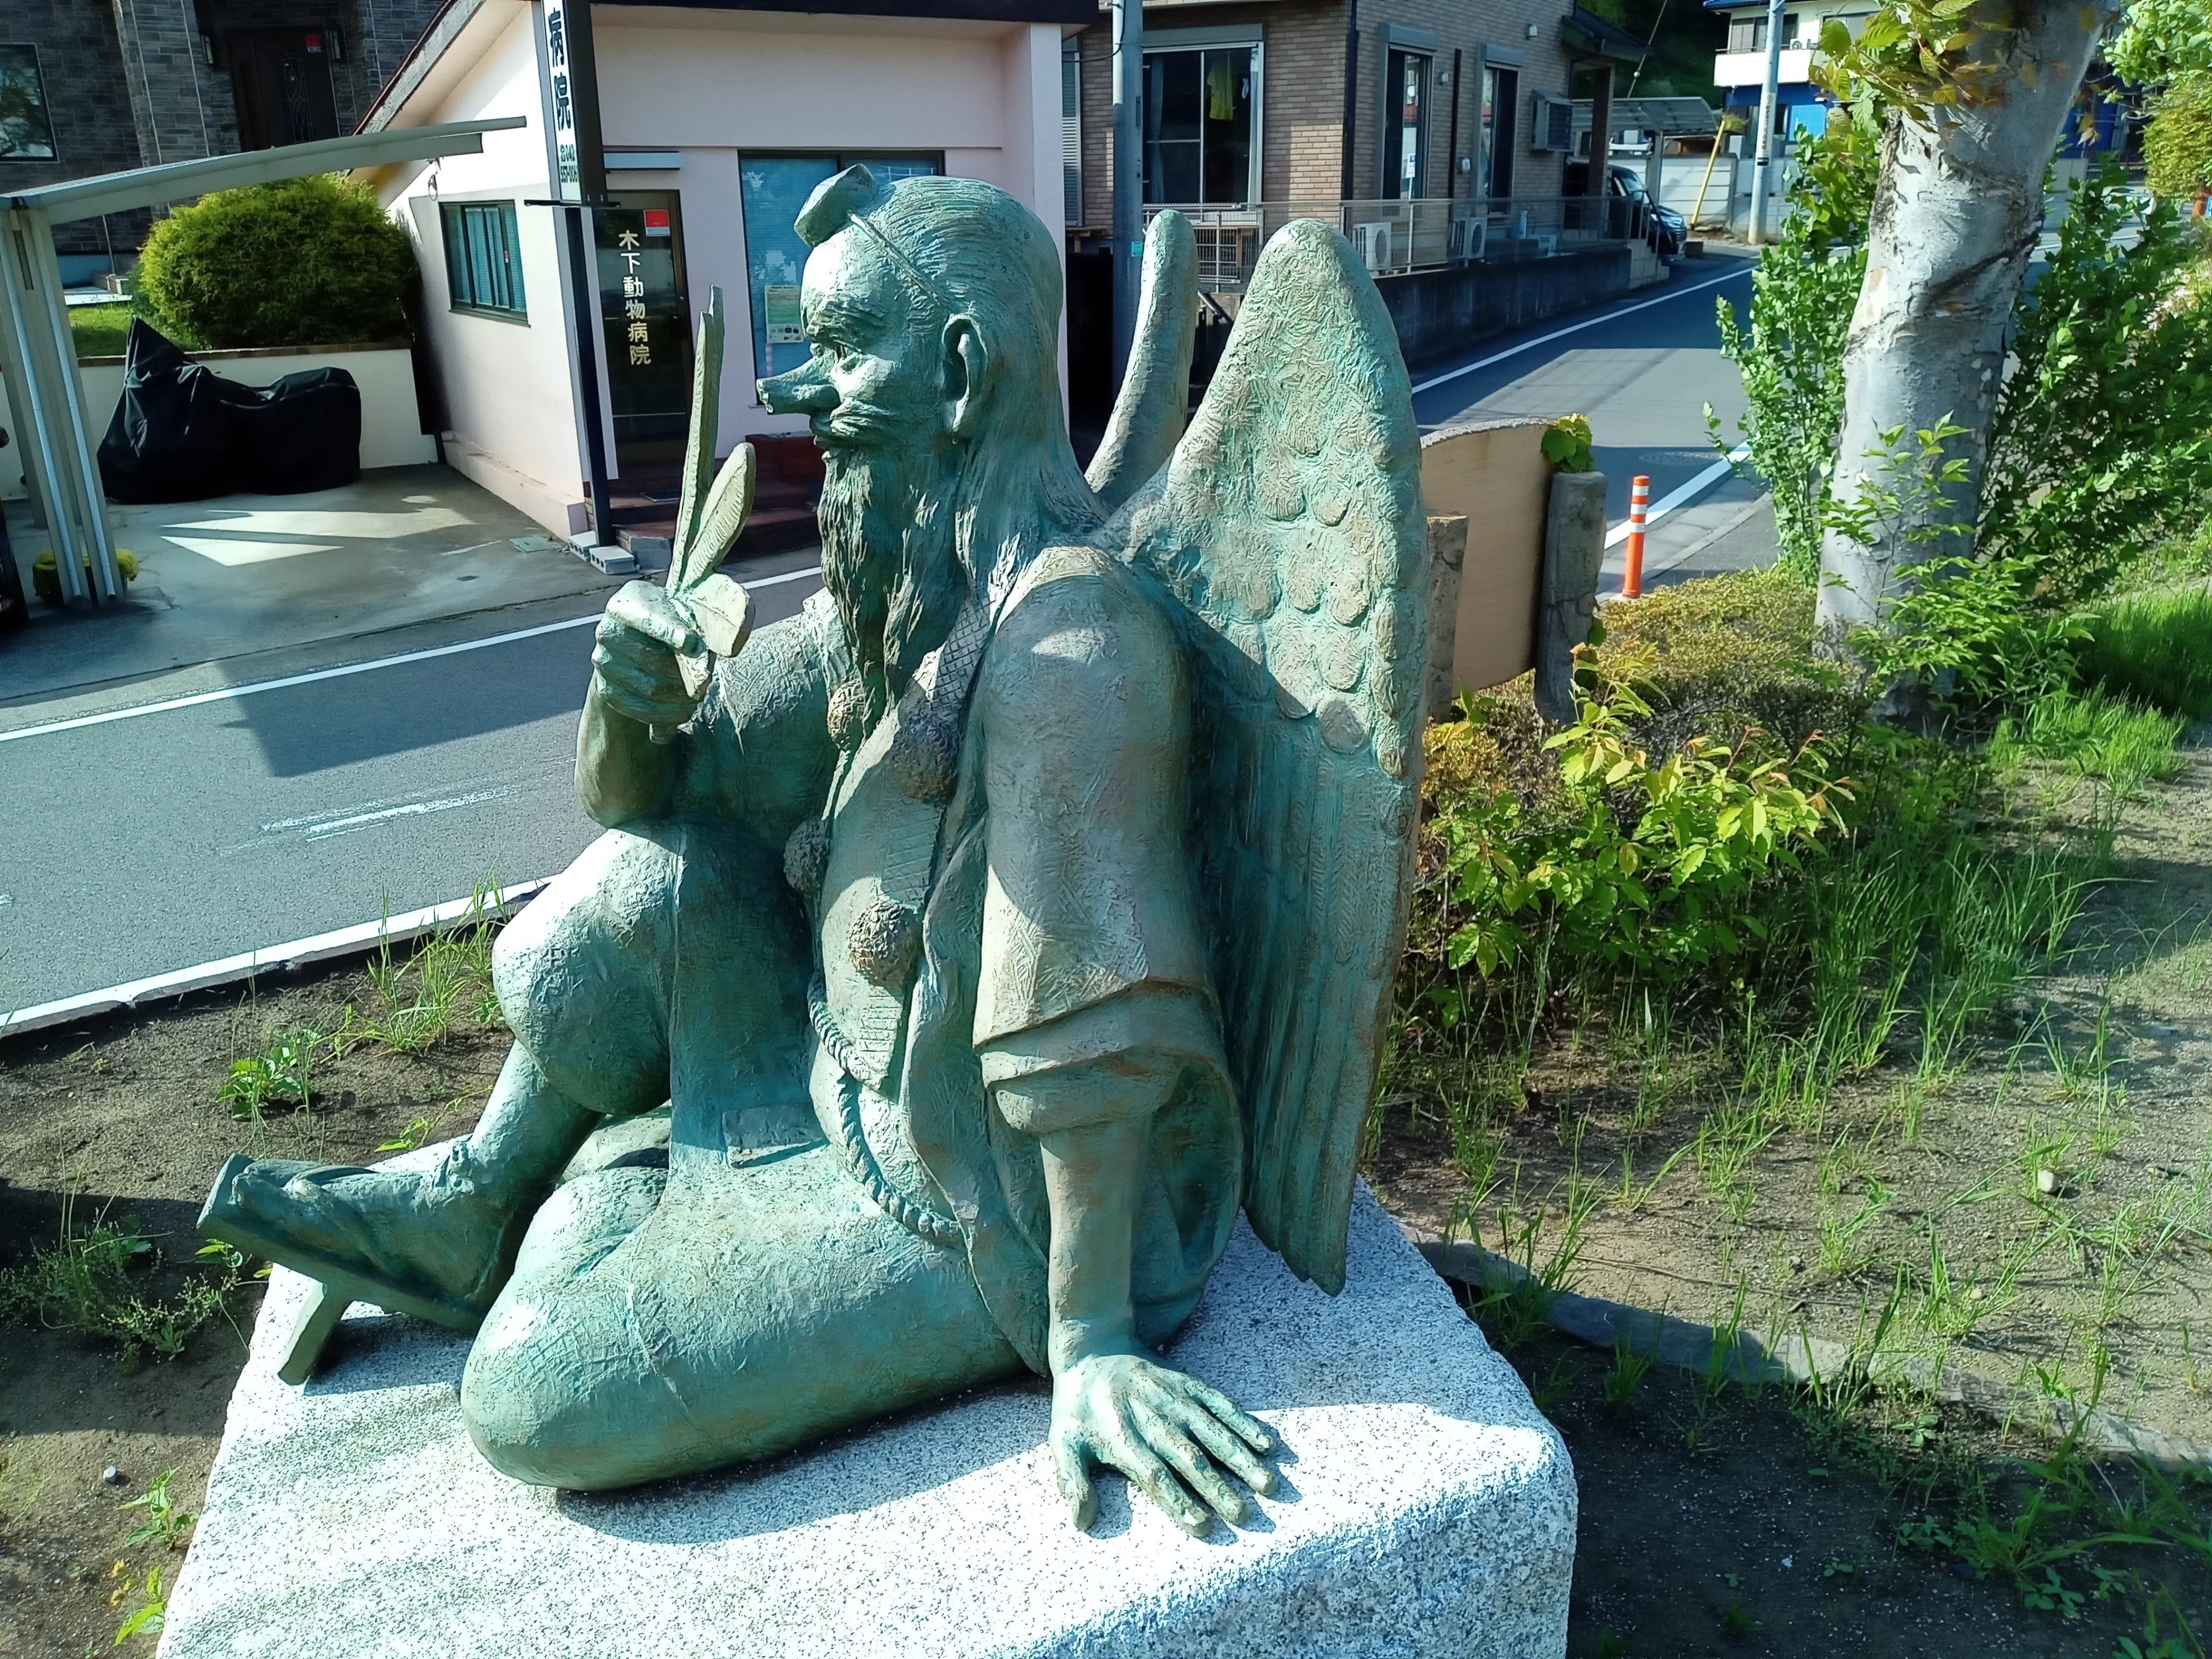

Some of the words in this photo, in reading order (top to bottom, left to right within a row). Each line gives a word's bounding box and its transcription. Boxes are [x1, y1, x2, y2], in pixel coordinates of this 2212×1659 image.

[548, 7, 571, 131] 病院
[619, 230, 651, 365] 木下動物病院
